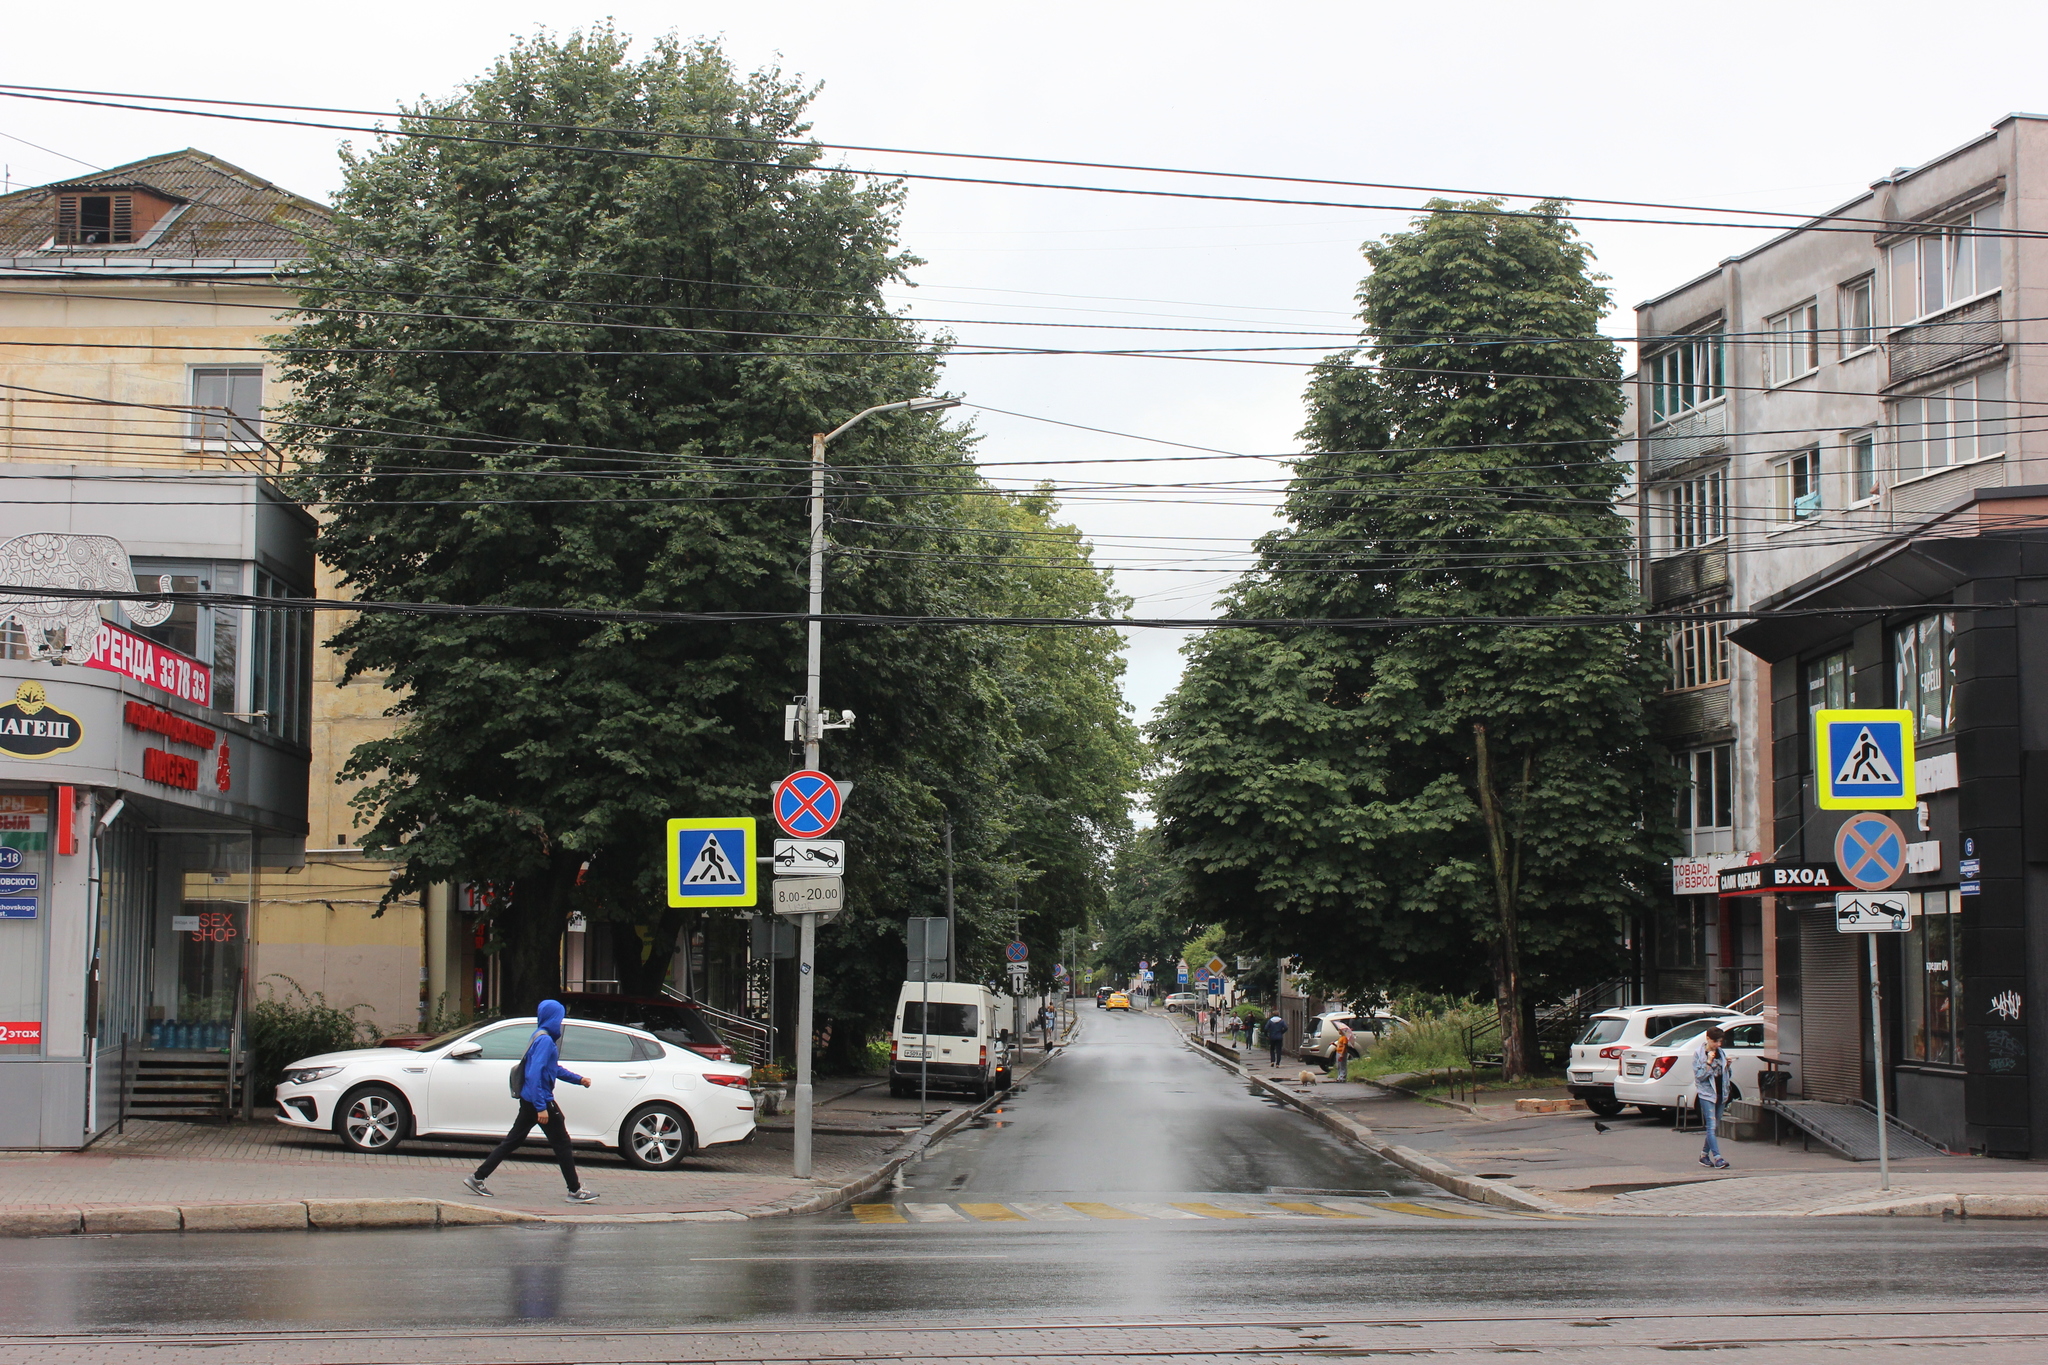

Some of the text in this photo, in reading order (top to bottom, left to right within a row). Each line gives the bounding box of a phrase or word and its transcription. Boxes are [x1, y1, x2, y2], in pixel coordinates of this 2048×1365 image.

[160, 656, 175, 690] 33
[177, 659, 191, 700] 78
[192, 670, 206, 702] 33
[1673, 863, 1710, 877] ТОВАРЫ
[1721, 870, 1761, 890] САЛОН ОДЕЖДЫ
[1774, 869, 1829, 886] ВХОД
[199, 913, 233, 927] SEX
[192, 928, 237, 942] SHOP
[8, 1030, 40, 1038] этаж
